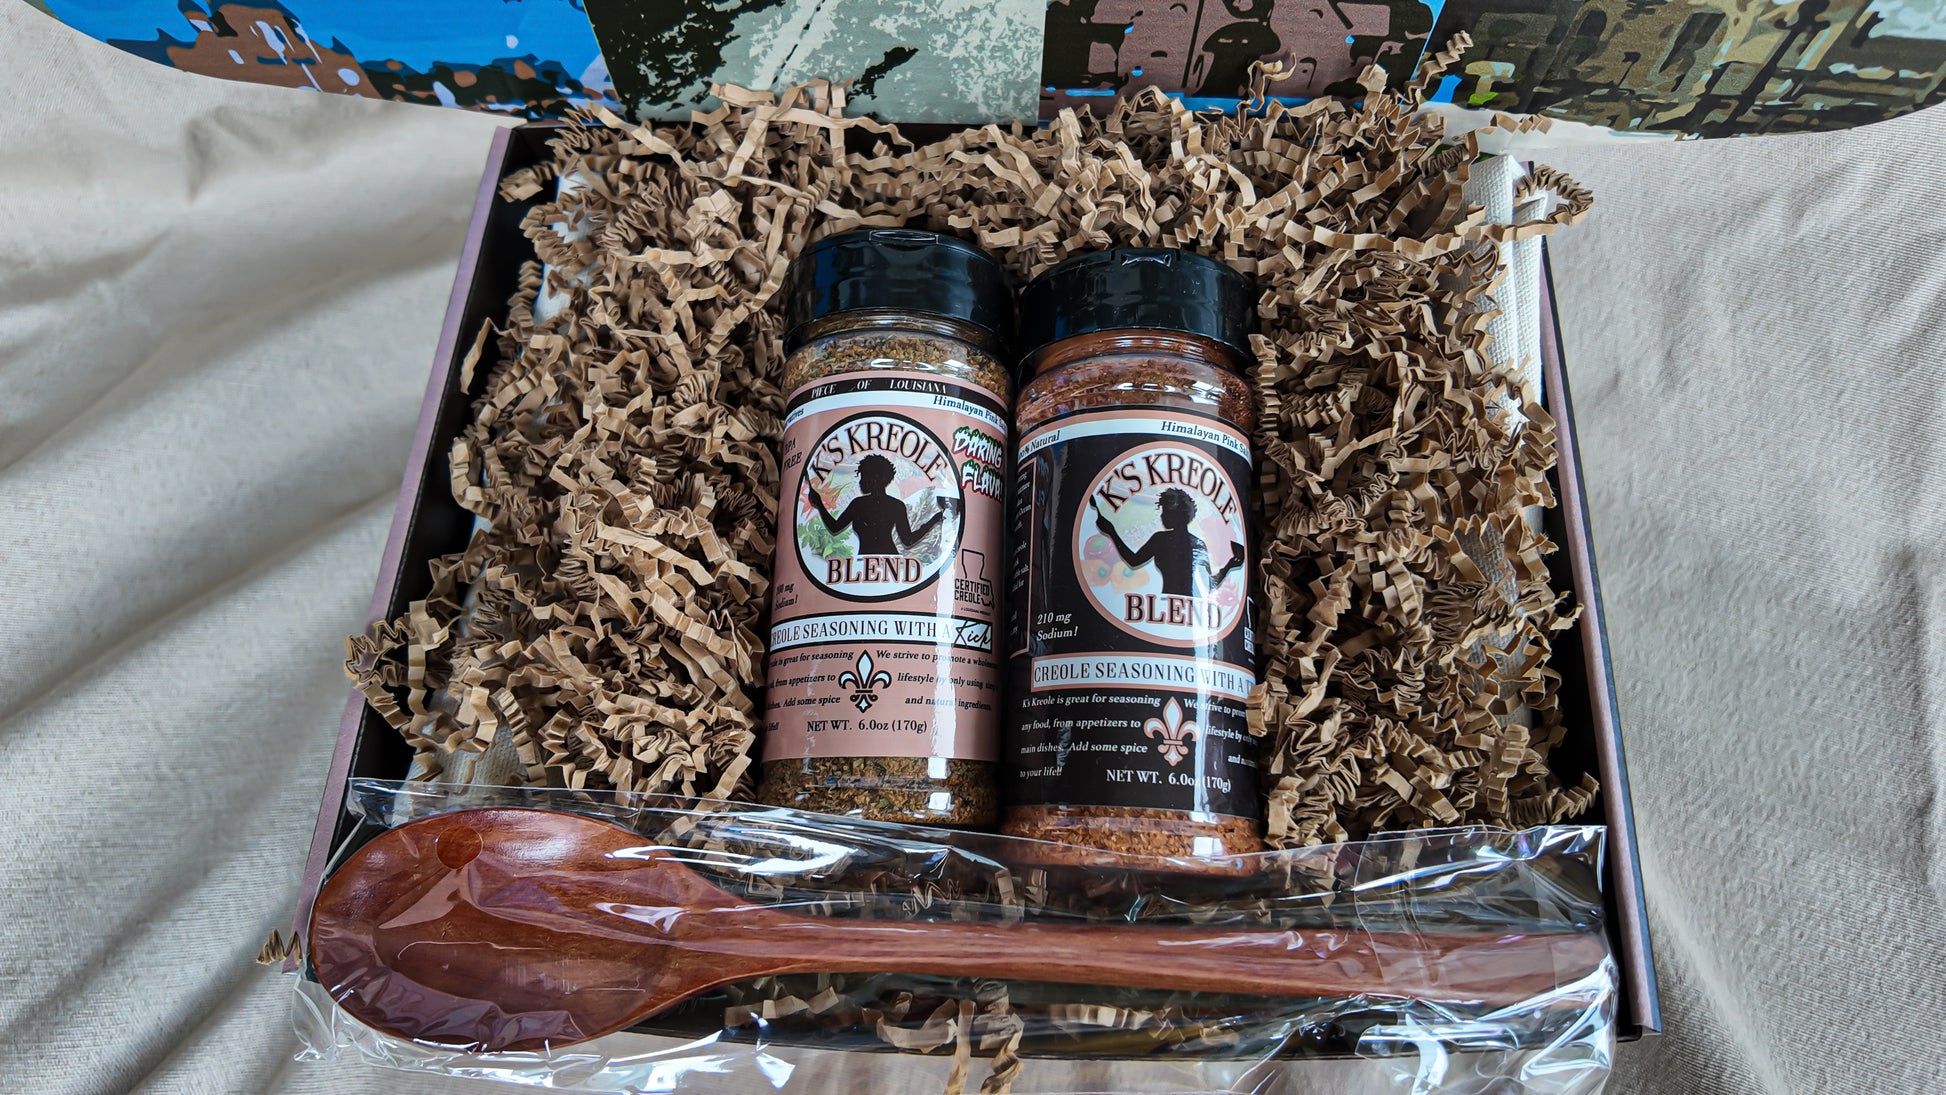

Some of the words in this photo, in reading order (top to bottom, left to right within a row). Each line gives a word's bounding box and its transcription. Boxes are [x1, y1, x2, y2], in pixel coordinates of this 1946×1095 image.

[811, 384, 838, 399] PIECE
[856, 379, 873, 390] OF
[889, 379, 948, 395] LOUISIANA
[932, 395, 984, 417] Himalayan
[1030, 430, 1061, 453] Natural
[1160, 420, 1220, 441] Himalayan
[1222, 433, 1239, 451] Pink
[809, 433, 845, 484] K'S
[844, 421, 949, 483] KREOLE
[952, 425, 1003, 470] DARING
[783, 451, 803, 471] FREE
[1098, 462, 1143, 514] K'S
[1142, 452, 1237, 525] KREOLE
[826, 555, 923, 585] BLEND
[954, 578, 990, 597] CERTIFIED
[954, 589, 981, 605] CREOLE
[1036, 612, 1054, 625] 210
[1055, 611, 1073, 624] mg
[802, 619, 889, 639] SEASONING
[894, 620, 937, 638] WITH
[941, 623, 951, 639] A
[1036, 625, 1079, 641] Sodium!
[799, 652, 810, 662] for
[811, 650, 855, 661] seasoning
[876, 649, 891, 659] We
[892, 650, 920, 660] strive
[921, 652, 931, 661] to
[788, 674, 826, 687] appetizers
[826, 673, 837, 682] to
[897, 672, 935, 684] lifestyle
[1034, 662, 1091, 683] CREOLE
[1095, 662, 1196, 683] SEASONING
[1200, 668, 1235, 690] WITH
[1237, 677, 1244, 693] A
[783, 696, 796, 707] Add
[796, 696, 816, 706] some
[817, 694, 841, 707] spice
[904, 695, 923, 705] and
[1031, 695, 1056, 707] Kreole
[1056, 694, 1064, 704] is
[1064, 695, 1090, 706] great
[1090, 693, 1107, 703] for
[1108, 694, 1162, 707] seasoning
[1223, 706, 1232, 715] to
[806, 720, 829, 732] NET
[830, 719, 853, 731] WT.
[857, 718, 890, 732] 6.0oz
[891, 719, 928, 734] (170g)
[1021, 722, 1032, 733] any
[1032, 720, 1051, 730] food,
[1052, 718, 1074, 728] from
[1075, 717, 1129, 730] appetizers
[1130, 719, 1142, 729] to
[1205, 725, 1235, 740] lifestyle
[1234, 730, 1243, 743] by
[1020, 743, 1036, 754] main
[1067, 741, 1089, 752] Add
[1090, 743, 1119, 752] some
[1120, 742, 1149, 755] spice
[1227, 754, 1241, 765] and
[1026, 768, 1042, 779] your
[1106, 768, 1134, 782] NET
[1135, 770, 1163, 785] WT.
